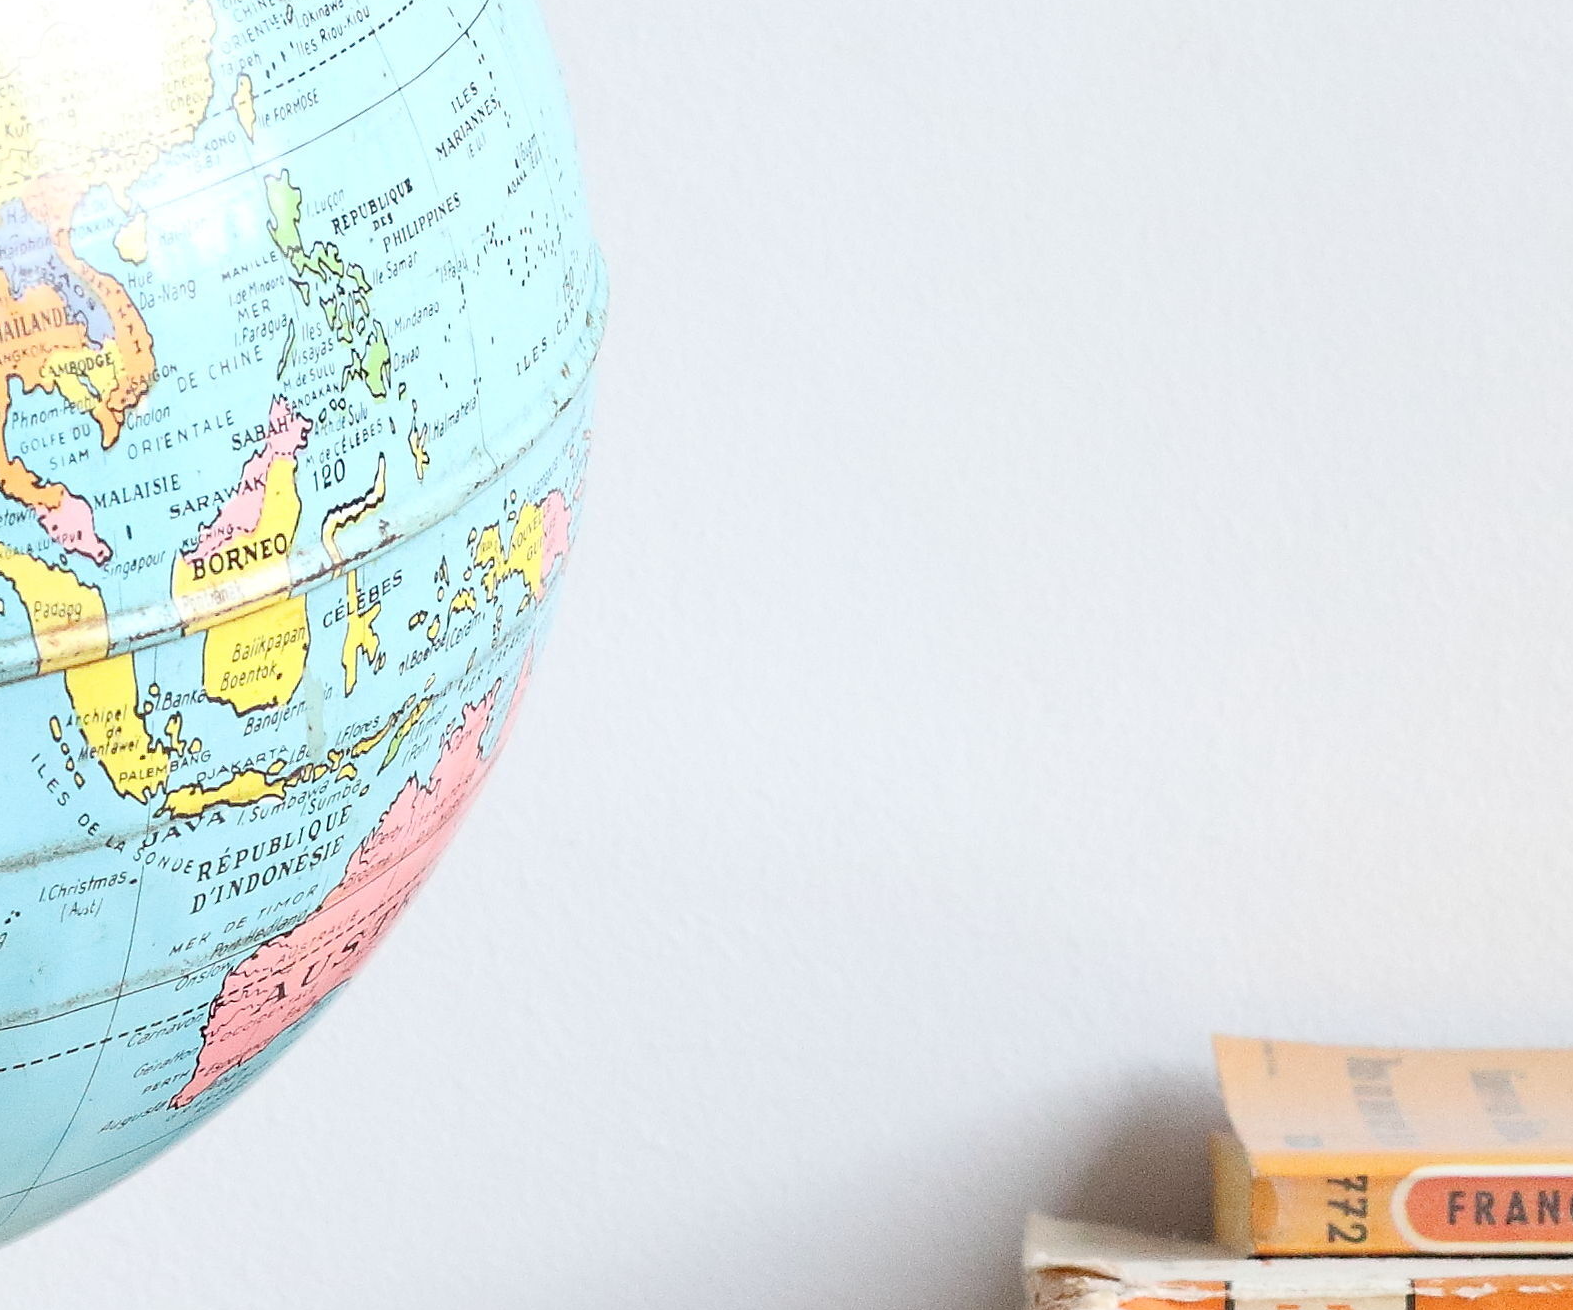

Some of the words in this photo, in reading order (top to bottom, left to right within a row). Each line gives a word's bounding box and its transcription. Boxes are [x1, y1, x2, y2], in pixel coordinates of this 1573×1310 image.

[372, 213, 394, 231] DES
[382, 192, 462, 253] PHILIPPINES
[139, 277, 196, 309] Da-Nang
[39, 352, 114, 380] CAMBODGE
[231, 417, 290, 452] SABAH
[93, 473, 181, 510] MALAISIE
[313, 459, 346, 489] 120
[169, 475, 265, 519] SARAWAK
[192, 533, 289, 580] BORNEO
[142, 811, 226, 850] JAVA
[195, 805, 353, 883] RÉPUBLIQUE
[191, 835, 345, 915] D'INDONÉSIE
[1327, 1175, 1368, 1243] 772
